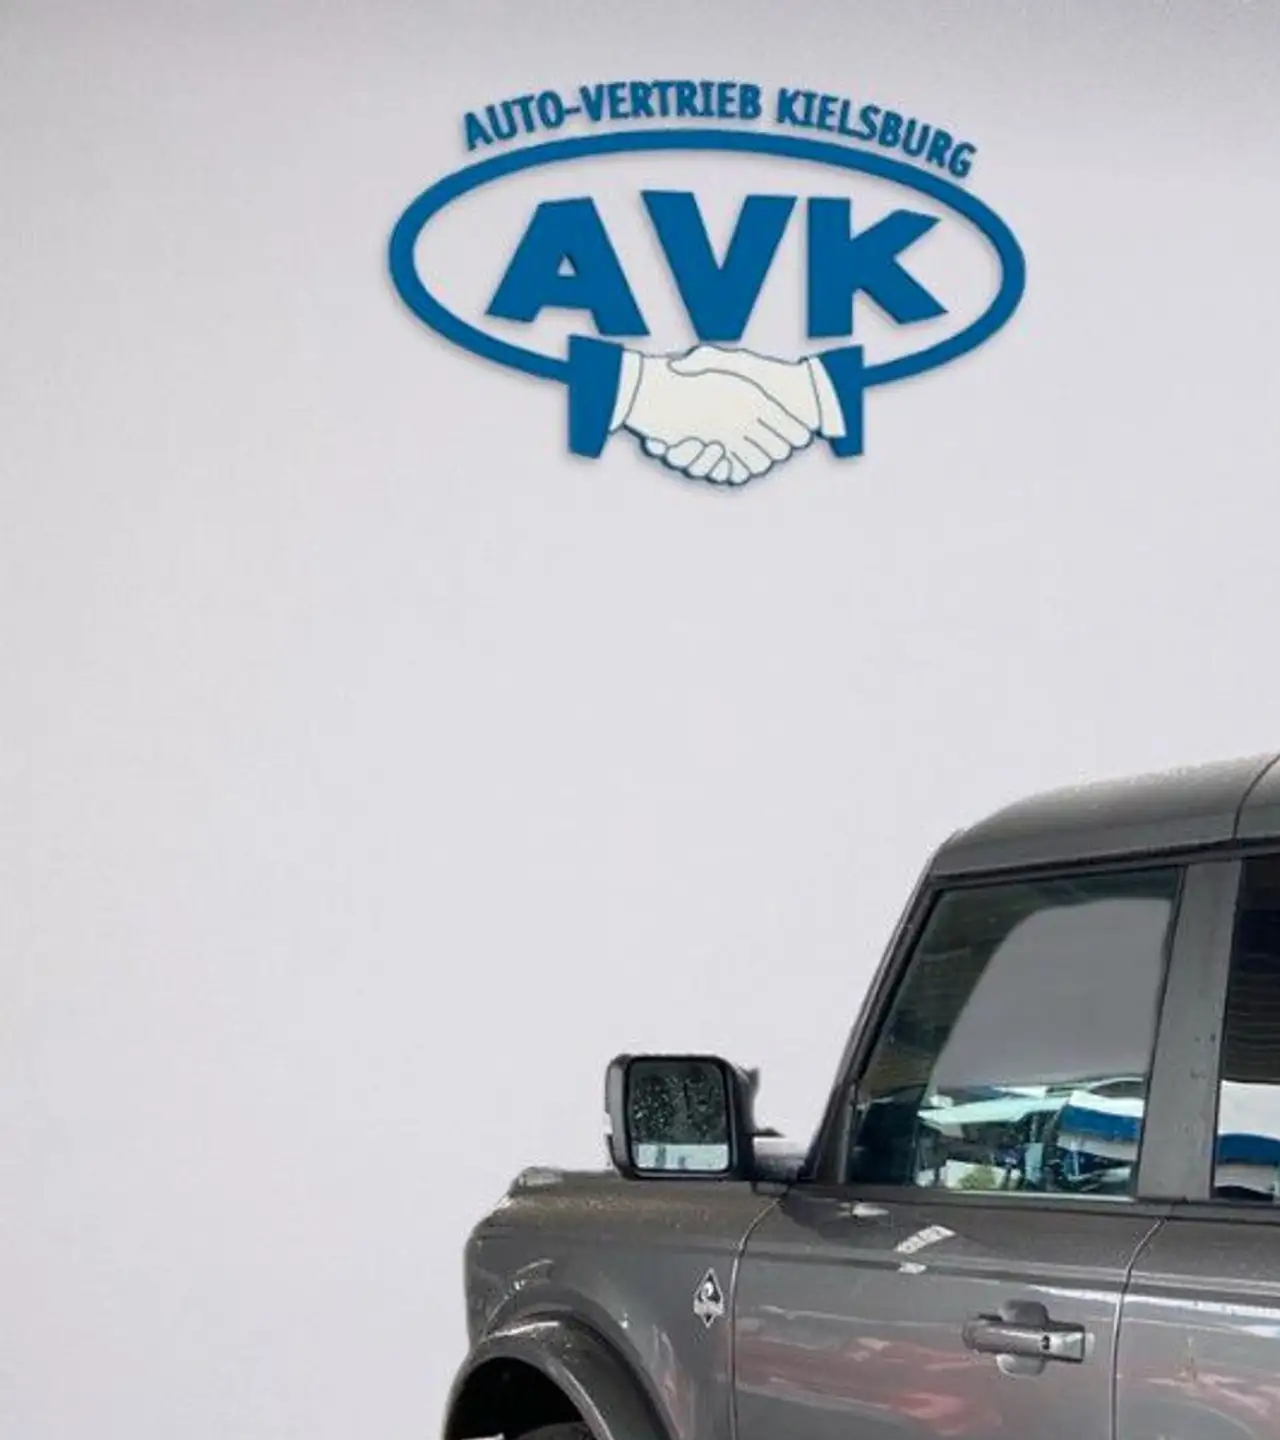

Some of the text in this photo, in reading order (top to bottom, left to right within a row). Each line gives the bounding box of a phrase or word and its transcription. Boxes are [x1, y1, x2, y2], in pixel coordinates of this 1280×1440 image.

[462, 79, 979, 178] AUTO-VERTRIEB KIELSBURG
[485, 188, 948, 343] AVK
